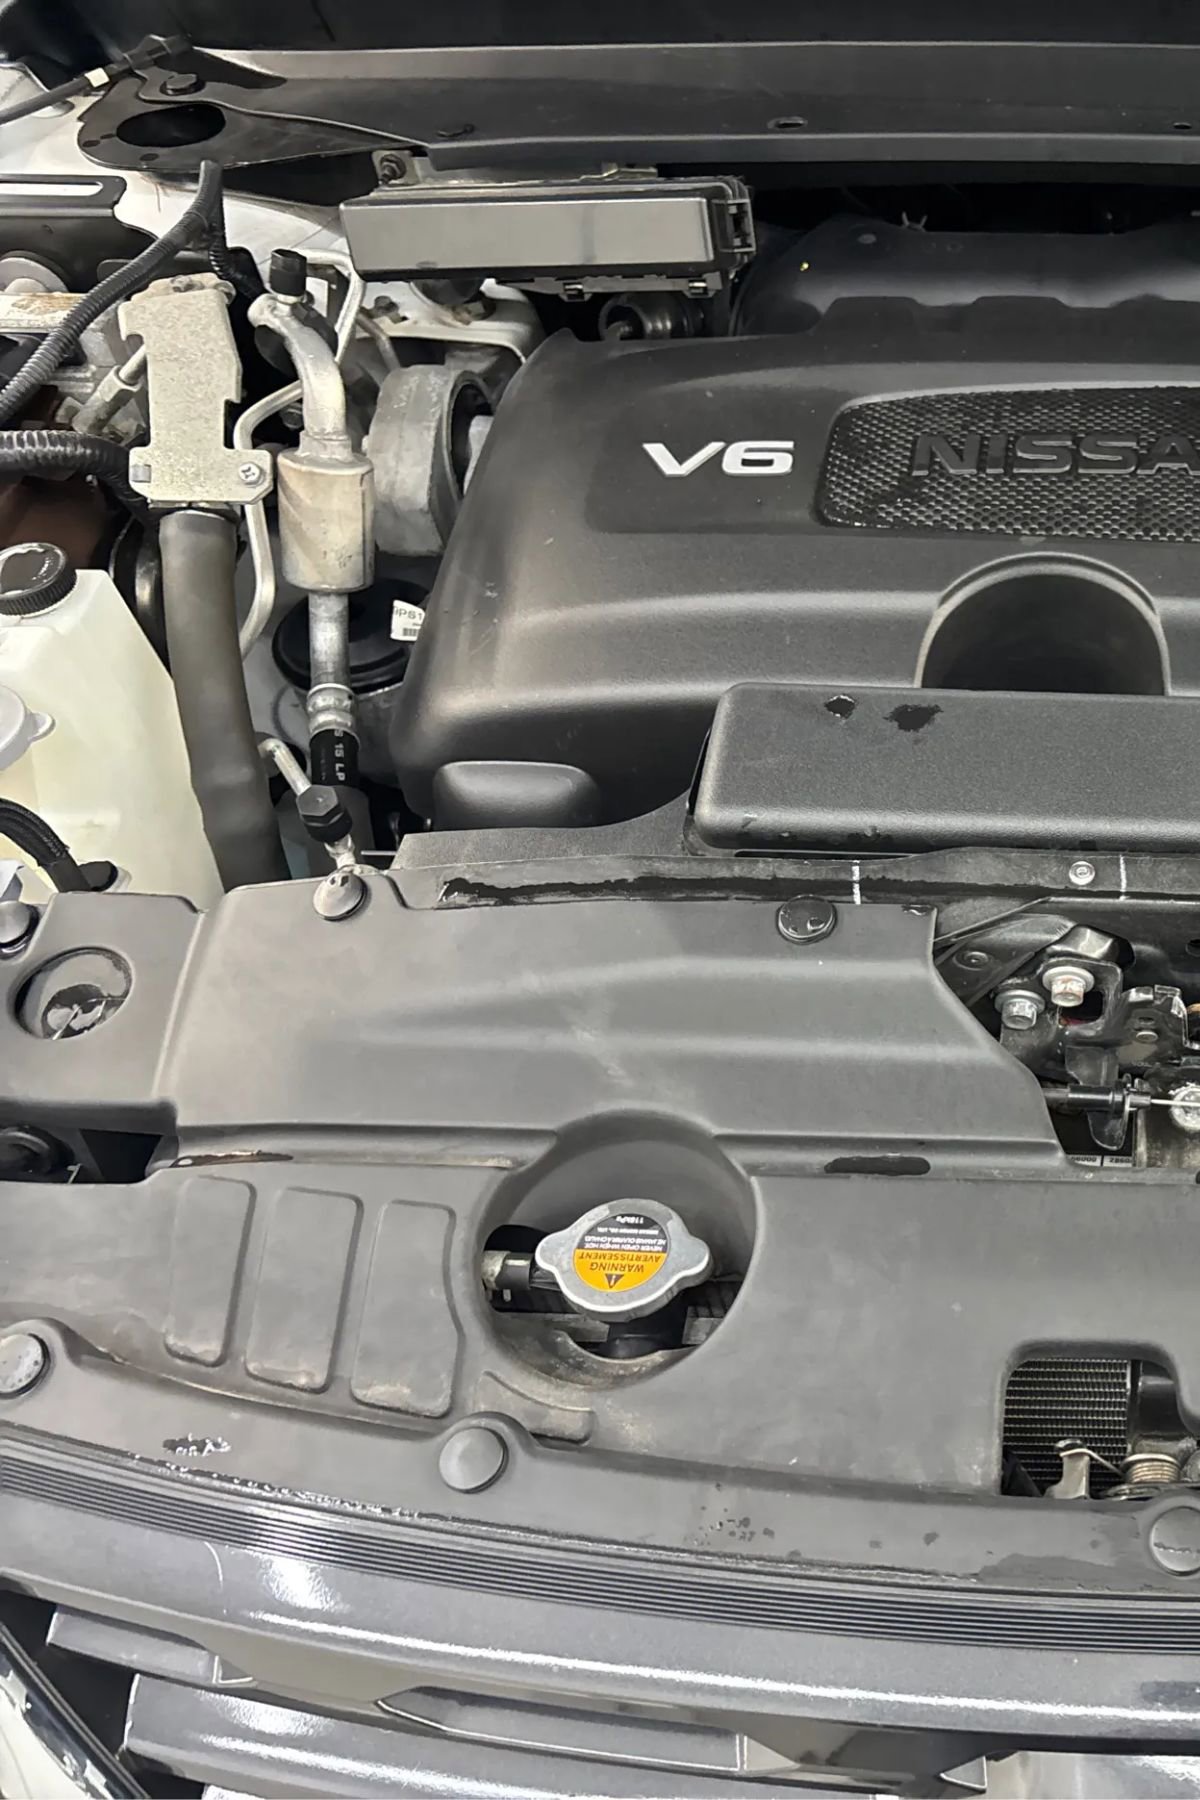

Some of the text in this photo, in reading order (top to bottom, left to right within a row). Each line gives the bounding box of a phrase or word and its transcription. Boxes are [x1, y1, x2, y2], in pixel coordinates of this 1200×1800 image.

[641, 440, 796, 478] V6
[334, 743, 345, 758] 15
[335, 763, 346, 781] LP
[579, 1252, 661, 1262] AVERTISSEMENT
[590, 1262, 644, 1272] WARNING
